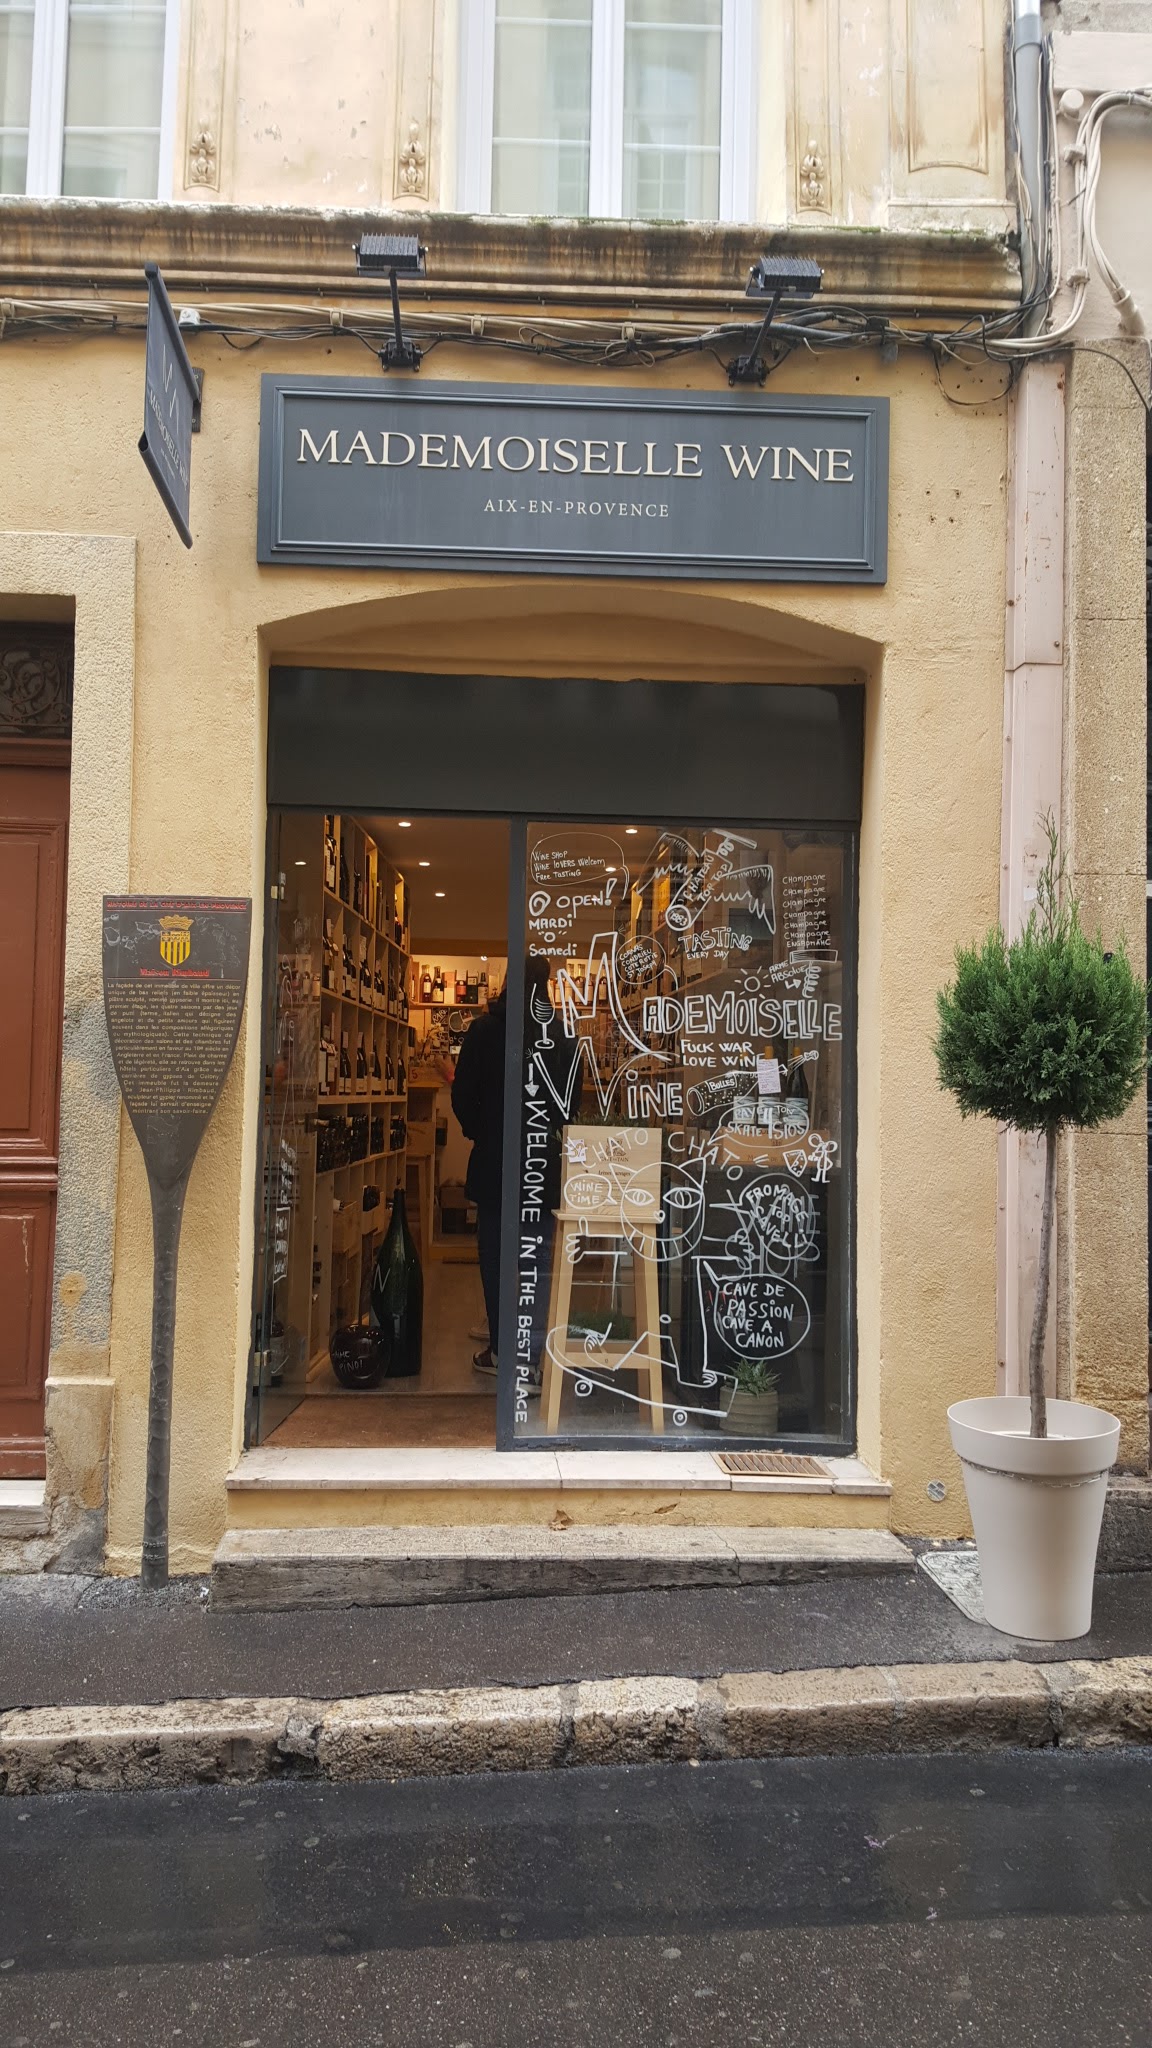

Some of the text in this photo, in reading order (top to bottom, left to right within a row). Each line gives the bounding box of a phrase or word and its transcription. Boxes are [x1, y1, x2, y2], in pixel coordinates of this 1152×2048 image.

[297, 428, 855, 483] MADEMOISELLE WINE
[484, 497, 671, 519] AIX-EN-PROVENCE
[528, 943, 578, 957] Samedi
[686, 950, 730, 961] EVERY DAY
[680, 1039, 756, 1055] FUCK WAR
[682, 1056, 718, 1068] LOVE
[775, 1104, 796, 1115] TON
[725, 1122, 763, 1137] SKATE
[521, 1099, 551, 1223] WELCOME
[667, 1131, 744, 1181] CHATO
[745, 1184, 810, 1223] FROMAGE
[519, 1265, 539, 1307] THE
[723, 1281, 786, 1298] CAVE DE
[722, 1315, 773, 1333] CAVE A
[516, 1314, 533, 1362] BEST
[736, 1331, 784, 1349] CANON
[514, 1364, 530, 1423] PLACE
